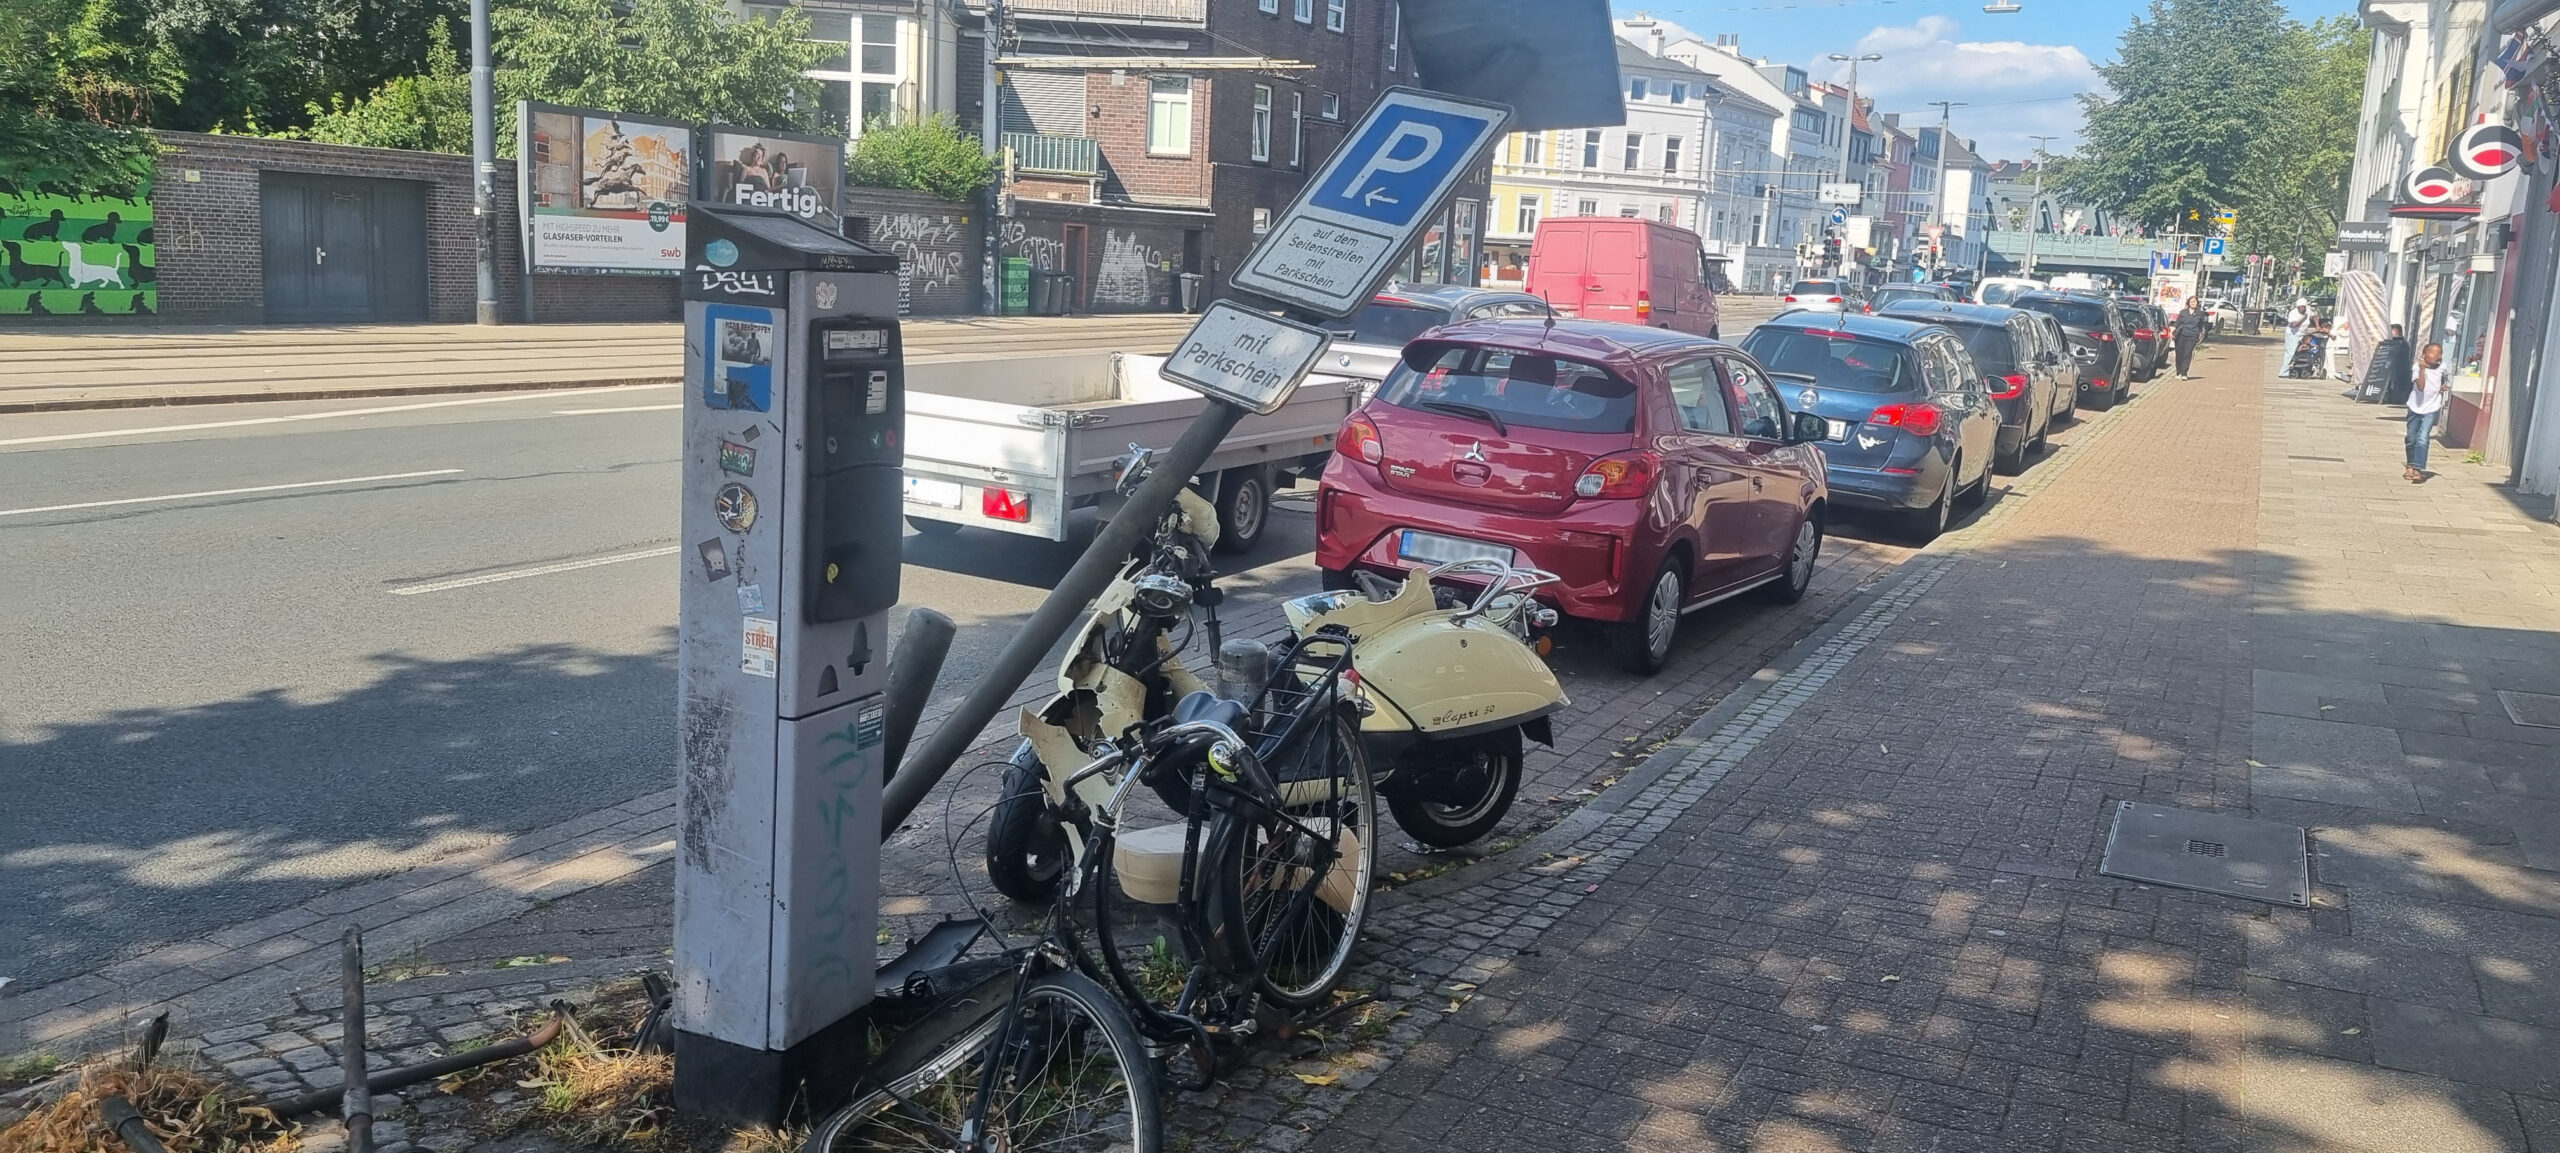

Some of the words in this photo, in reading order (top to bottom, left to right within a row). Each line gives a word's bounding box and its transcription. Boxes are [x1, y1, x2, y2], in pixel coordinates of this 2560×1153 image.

[1341, 120, 1443, 199] P
[735, 183, 824, 219] Fertig.
[542, 223, 554, 231] MIT
[555, 223, 591, 232] HIGHSPEED
[603, 225, 620, 233] MEHR
[543, 232, 623, 243] GLASFASER-VORTEILEN
[1313, 229, 1334, 240] auf
[1334, 233, 1359, 247] dem
[2208, 240, 2220, 253] P
[661, 246, 681, 258] swb
[1288, 236, 1364, 264] Seitenstreifen
[1305, 258, 1326, 270] mit
[1275, 263, 1335, 288] Parkschein
[1234, 334, 1272, 355] mit
[1183, 342, 1282, 389] Parkschein
[745, 631, 775, 650] STREIK
